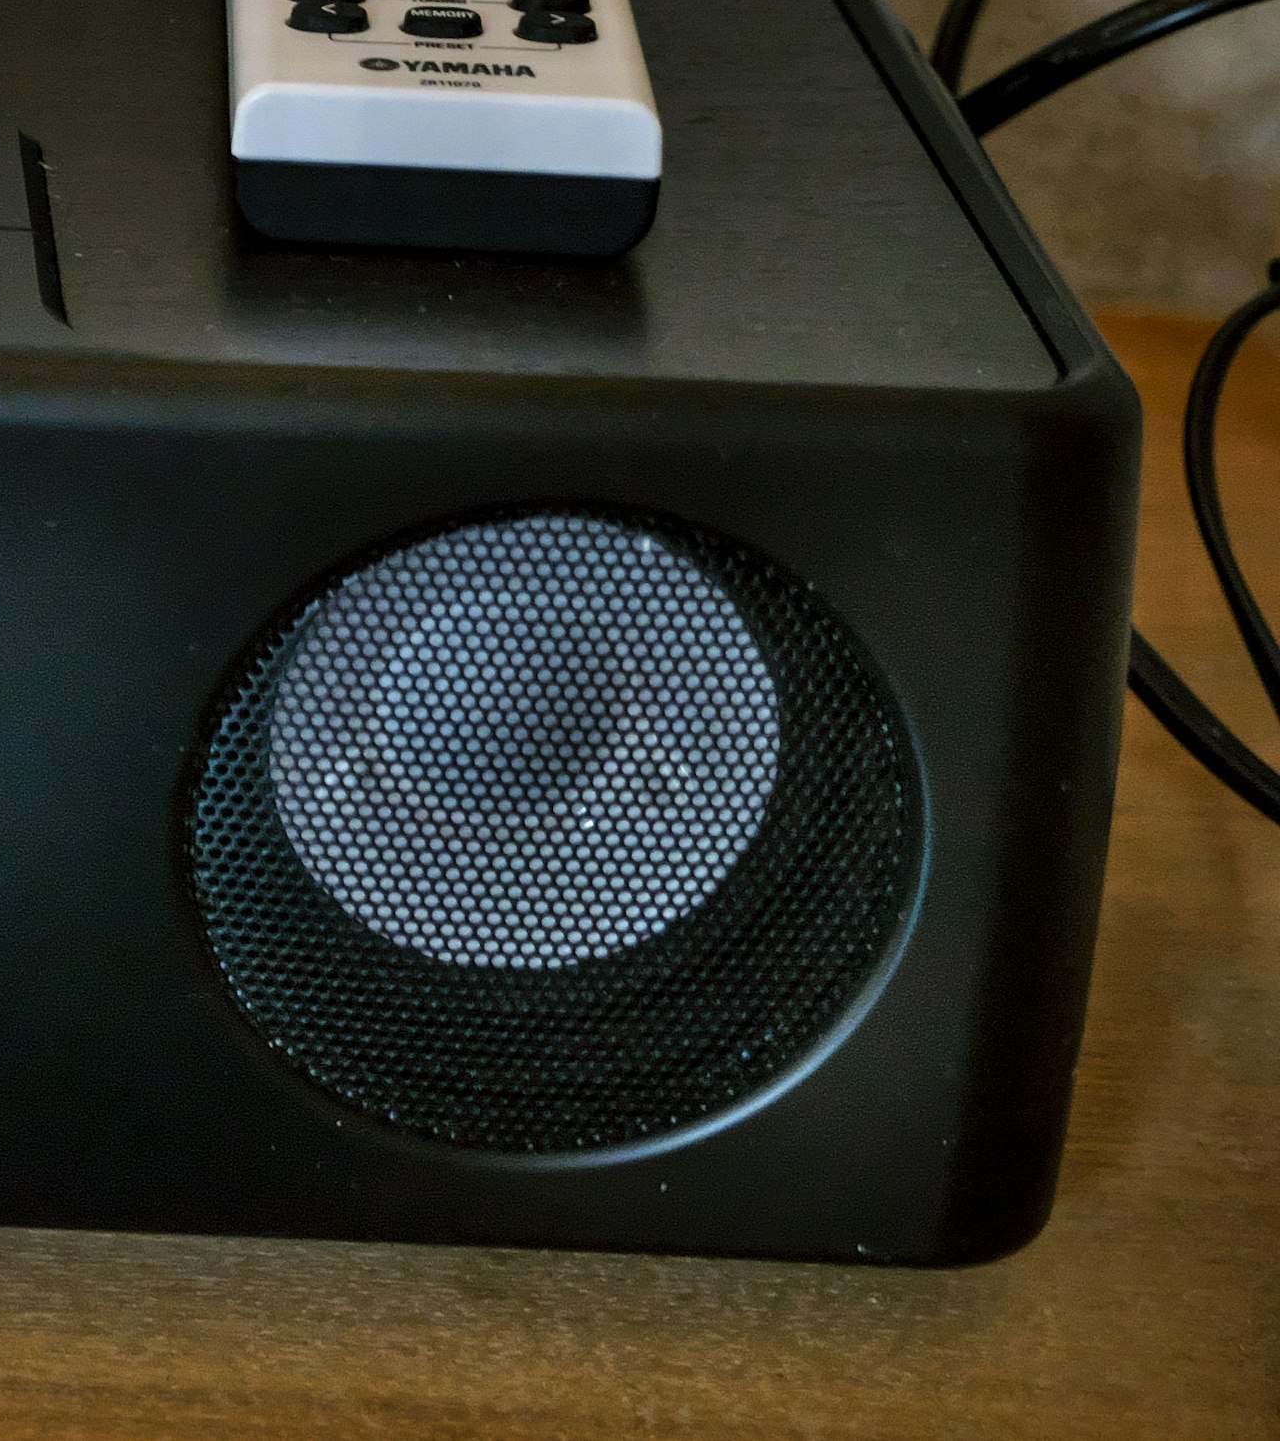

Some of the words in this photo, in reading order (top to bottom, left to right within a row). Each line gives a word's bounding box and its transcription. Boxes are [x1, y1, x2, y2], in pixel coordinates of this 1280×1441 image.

[410, 8, 475, 19] MEMORY
[414, 40, 474, 51] PRESET
[402, 59, 537, 78] YAMAHA
